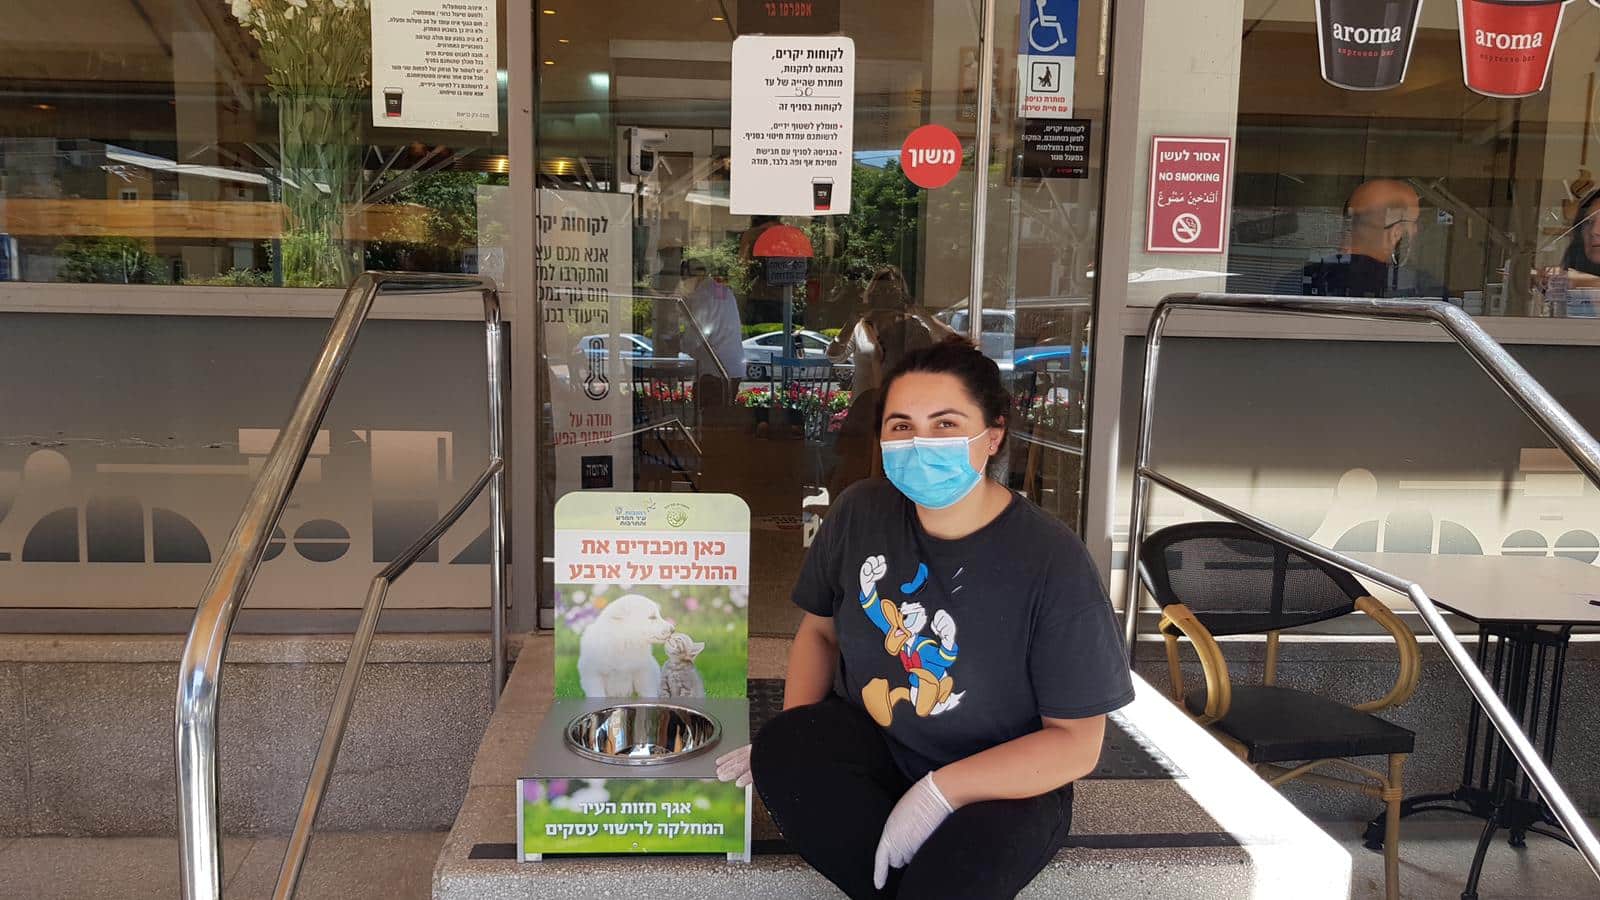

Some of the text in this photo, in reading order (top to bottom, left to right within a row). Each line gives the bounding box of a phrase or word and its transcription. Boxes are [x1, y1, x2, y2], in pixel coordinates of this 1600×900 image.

[1332, 22, 1401, 44] aroma
[1475, 28, 1543, 50] aroma
[772, 48, 843, 61] לקוחות יקרים,
[1337, 48, 1395, 57] espresso bar
[1522, 54, 1536, 62] bar
[781, 64, 812, 74] לתקנות,
[777, 77, 788, 86] של
[791, 104, 811, 112] בסניף
[815, 102, 842, 112] לקוחות
[1059, 105, 1068, 113] עם
[792, 122, 814, 131] לשטוף
[816, 122, 838, 131] מומלץ
[786, 132, 804, 140] עמדת
[793, 148, 811, 157] לסניף
[908, 148, 956, 168] משוך
[1160, 149, 1221, 163] אסור לעשן
[1159, 172, 1220, 182] NO SMOKING
[561, 216, 608, 236] לקוחות
[556, 246, 580, 261] מכם
[584, 248, 608, 262] אנא
[560, 266, 608, 285] והתקרבו
[588, 287, 608, 303] חום
[569, 308, 608, 324] הייעודי
[570, 411, 612, 427] תודה על
[581, 539, 726, 561] כאן מכבדים את
[568, 561, 737, 580] ההולכים על ארבע
[579, 802, 692, 818] אגף חזות העיר
[545, 820, 725, 840] המחלקה לרישוי עסקים
